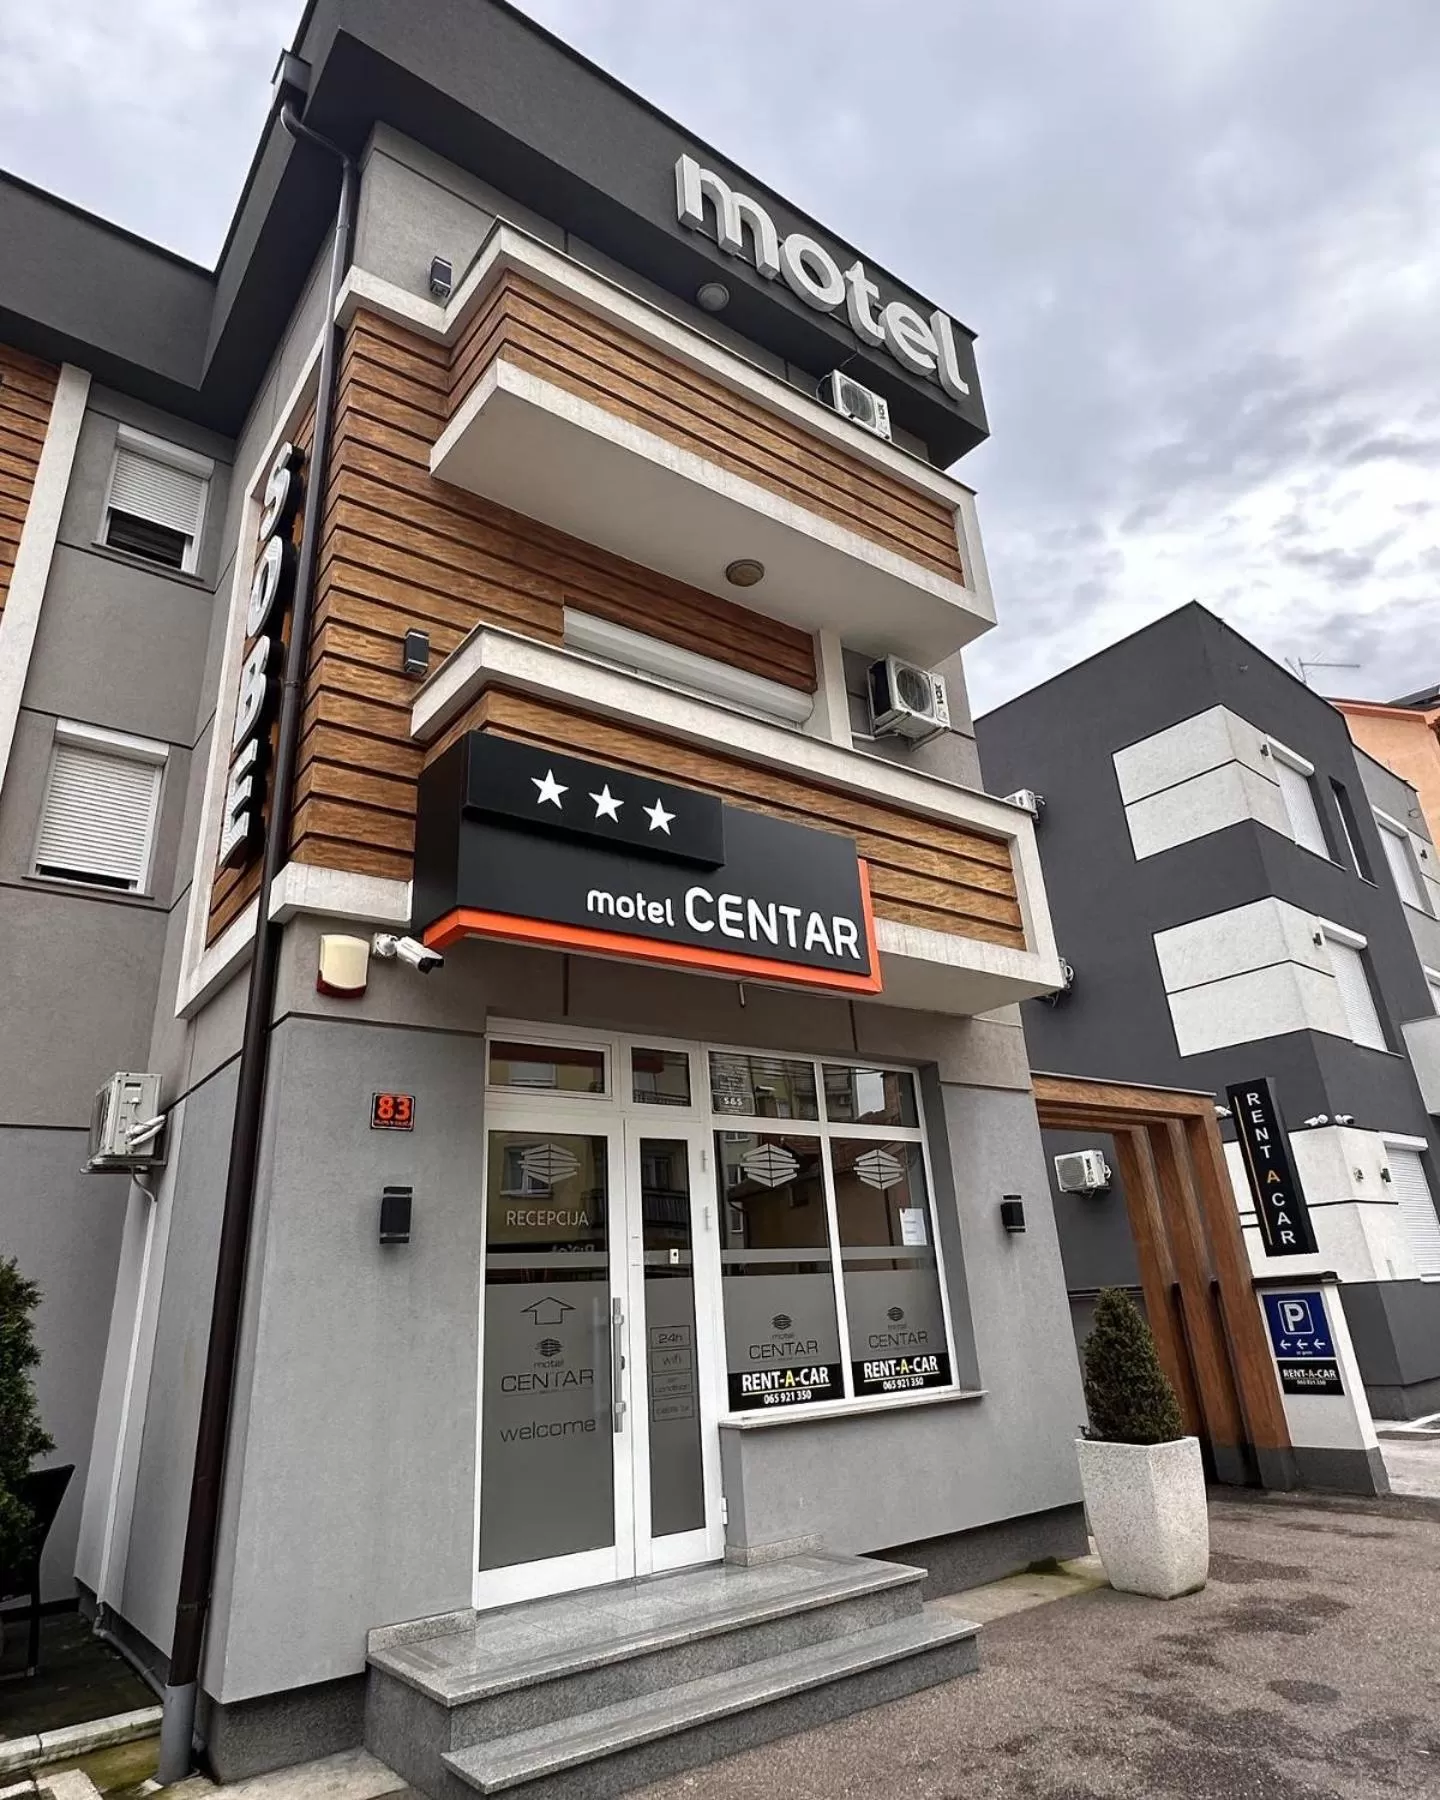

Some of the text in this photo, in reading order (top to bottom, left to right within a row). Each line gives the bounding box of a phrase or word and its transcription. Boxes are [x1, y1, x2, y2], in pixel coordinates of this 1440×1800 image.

[674, 153, 969, 401] motel
[587, 886, 861, 959] motel CENTAR
[378, 1095, 410, 1120] 83
[1246, 1092, 1296, 1244] RENT A CAR
[506, 1210, 589, 1227] RECEPCIJA
[1283, 1303, 1304, 1331] P
[749, 1340, 819, 1359] CENTAR
[868, 1331, 928, 1349] CENTAR
[864, 1355, 938, 1379] RENT-A-CAR
[1283, 1369, 1337, 1379] RENT-A-CAR
[501, 1369, 594, 1393] CENTAR
[742, 1366, 830, 1393] RENT-A-CAR
[882, 1376, 924, 1391] 065 921 350
[763, 1389, 812, 1405] 065 921 350
[500, 1419, 596, 1443] welcome
